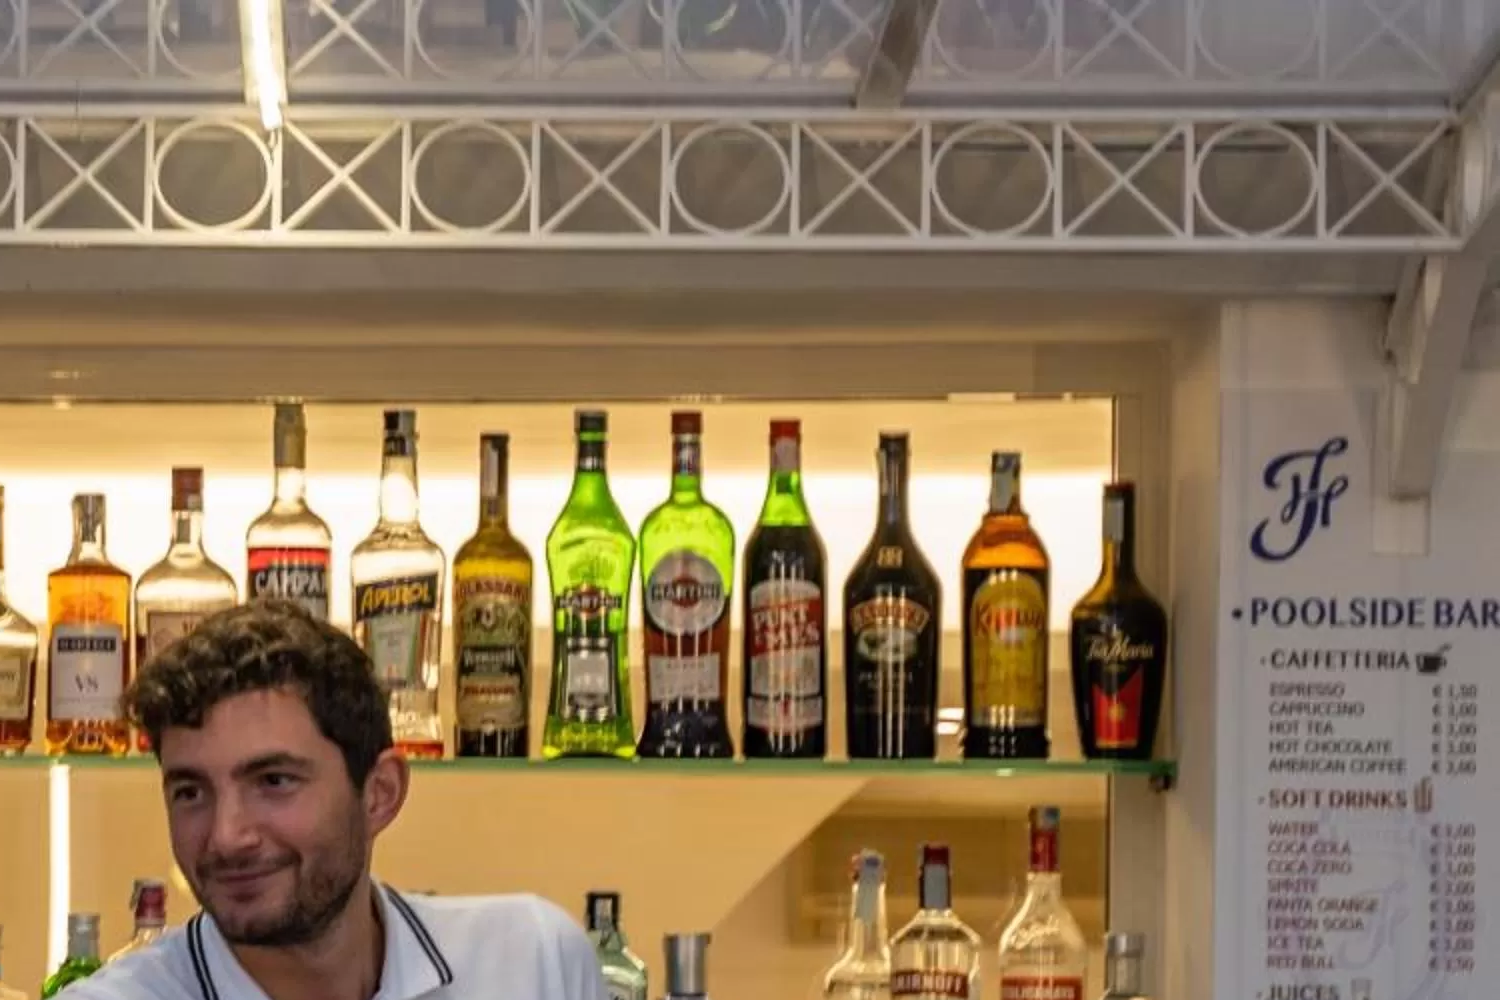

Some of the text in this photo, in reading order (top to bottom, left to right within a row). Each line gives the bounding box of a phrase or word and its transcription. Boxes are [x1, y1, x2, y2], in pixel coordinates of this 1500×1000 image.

[650, 583, 721, 602] MARTINI
[1250, 597, 1500, 629] POOLSIDE BAR
[1270, 649, 1410, 671] CAFFETTERIA
[1269, 681, 1345, 699] ESPRESSO
[1269, 701, 1365, 717] CAPPUCCINO
[1269, 720, 1334, 735] HOT TEA
[1269, 739, 1392, 754] HOT CHOCOLATE
[1268, 757, 1345, 774] AMERICAN
[1268, 788, 1407, 810] SOFT DRINKS
[1268, 821, 1319, 836] WATER
[893, 974, 962, 995] MIRNOFF
